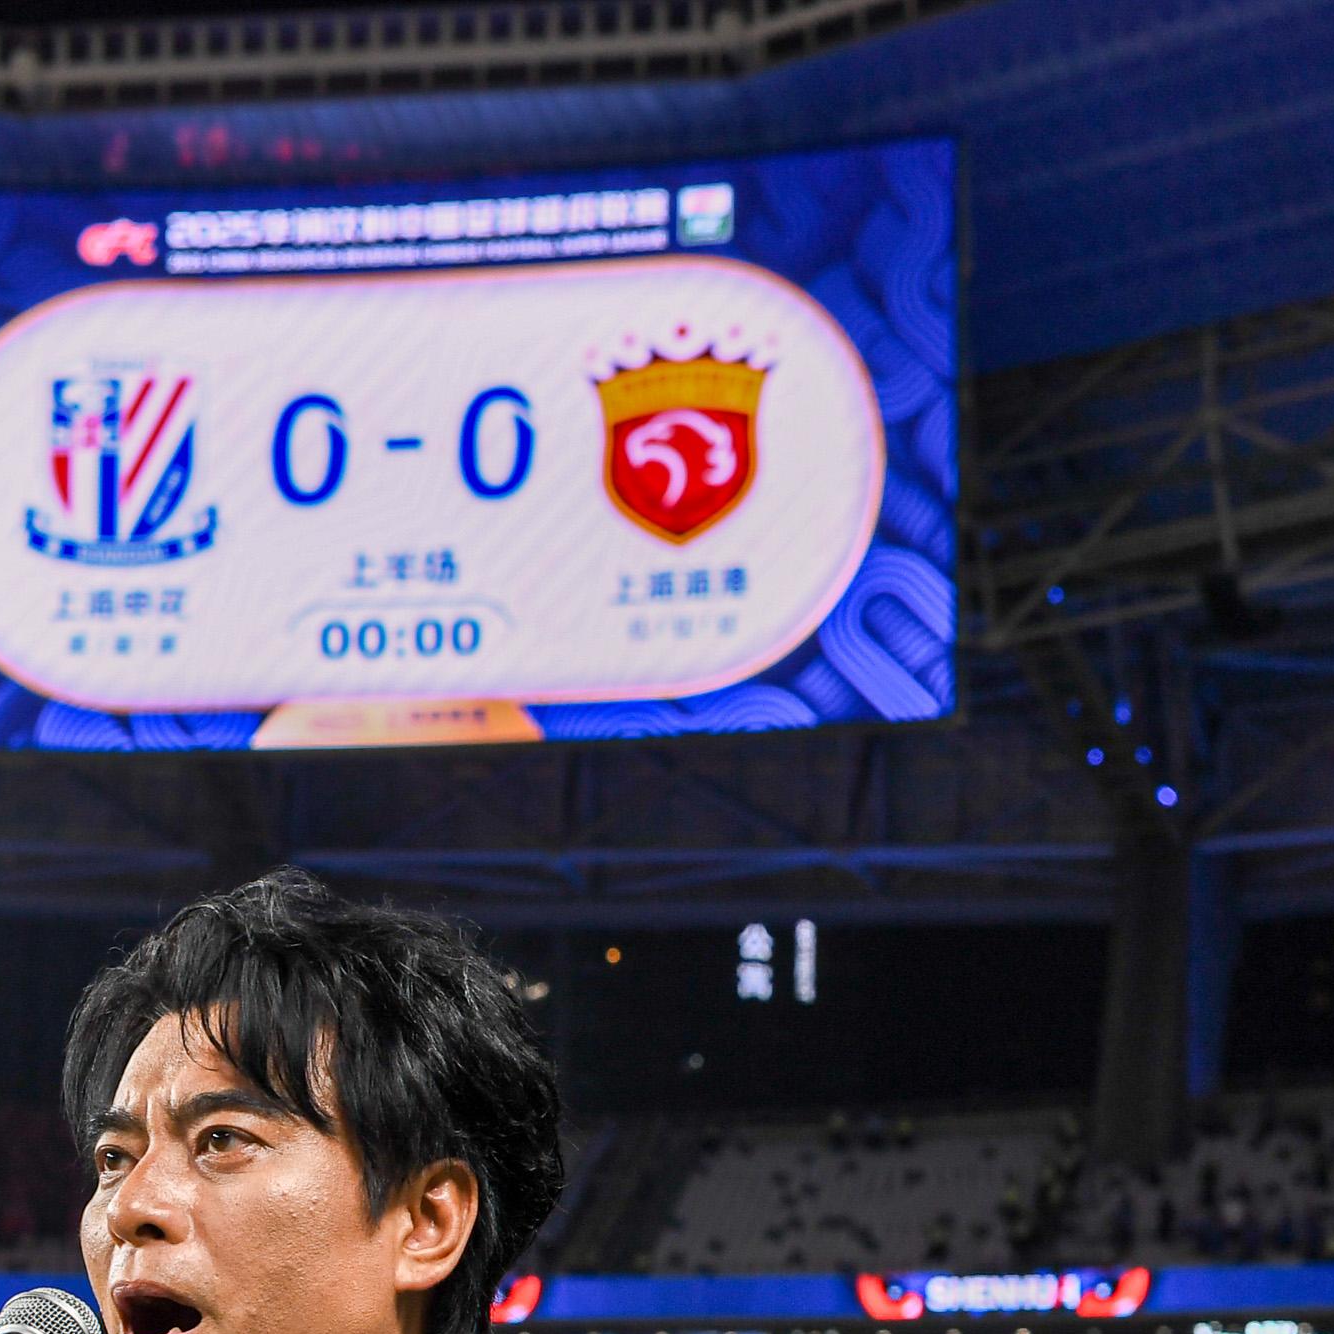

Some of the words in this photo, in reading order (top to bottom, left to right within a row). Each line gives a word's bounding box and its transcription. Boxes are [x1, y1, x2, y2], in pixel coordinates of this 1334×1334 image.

[271, 392, 348, 507] 0
[459, 384, 535, 501] 0
[320, 617, 481, 660] 00:00
